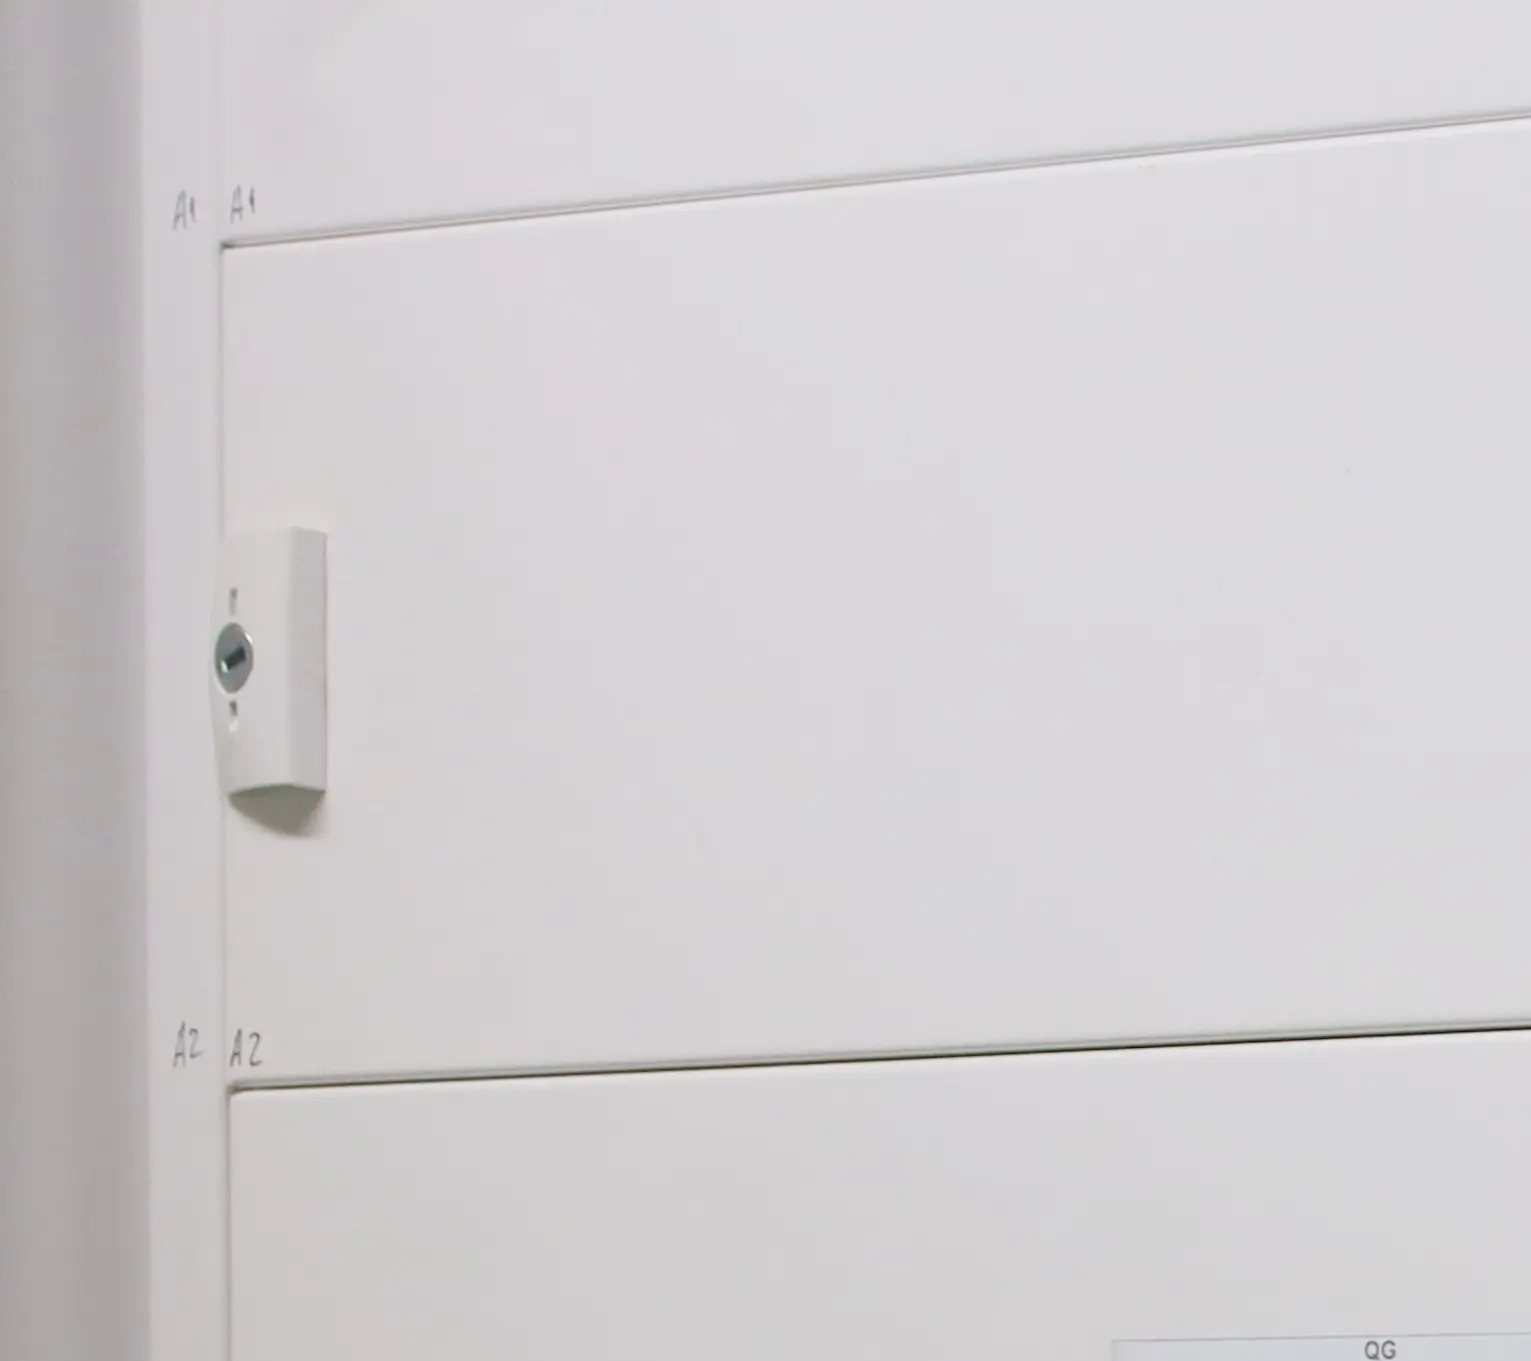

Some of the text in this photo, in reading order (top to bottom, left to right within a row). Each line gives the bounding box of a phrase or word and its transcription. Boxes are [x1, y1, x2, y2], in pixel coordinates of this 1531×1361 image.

[171, 1019, 204, 1070] A2
[228, 1027, 264, 1069] A2
[1364, 1339, 1396, 1361] QG
